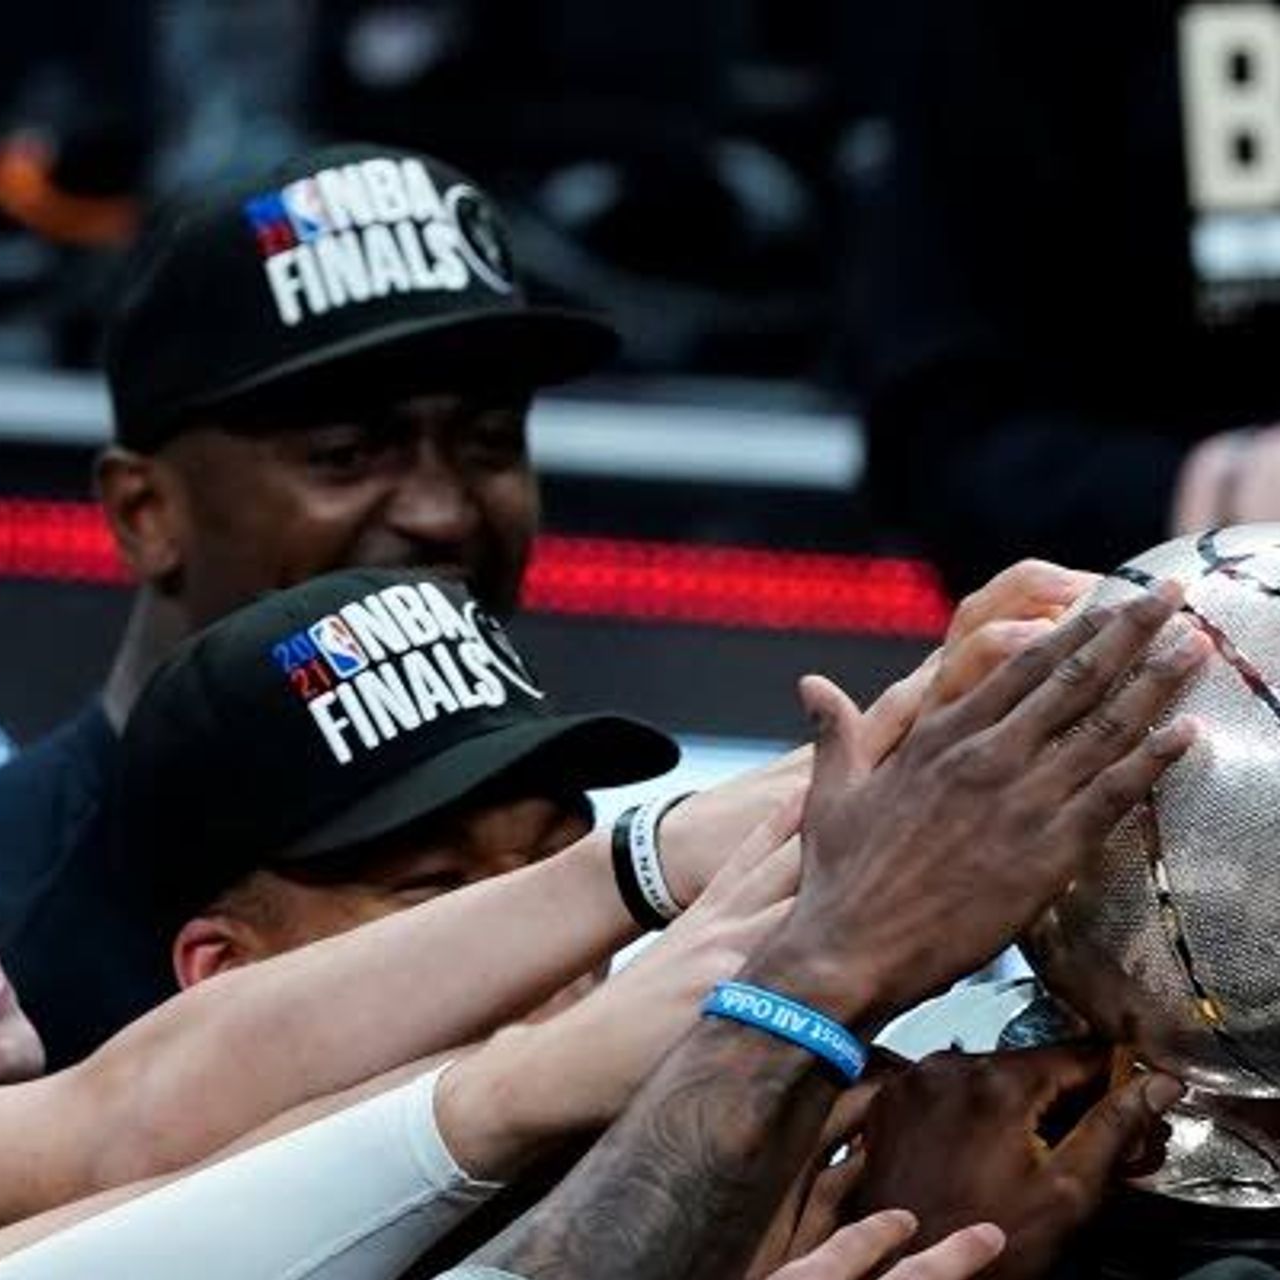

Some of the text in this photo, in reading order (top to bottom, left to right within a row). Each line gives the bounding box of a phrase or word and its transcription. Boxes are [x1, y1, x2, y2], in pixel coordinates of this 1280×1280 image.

[316, 157, 450, 232] NBA
[265, 219, 471, 326] FINALS
[338, 581, 477, 662] NBA
[306, 639, 508, 766] FINALS
[771, 1006, 811, 1032] All
